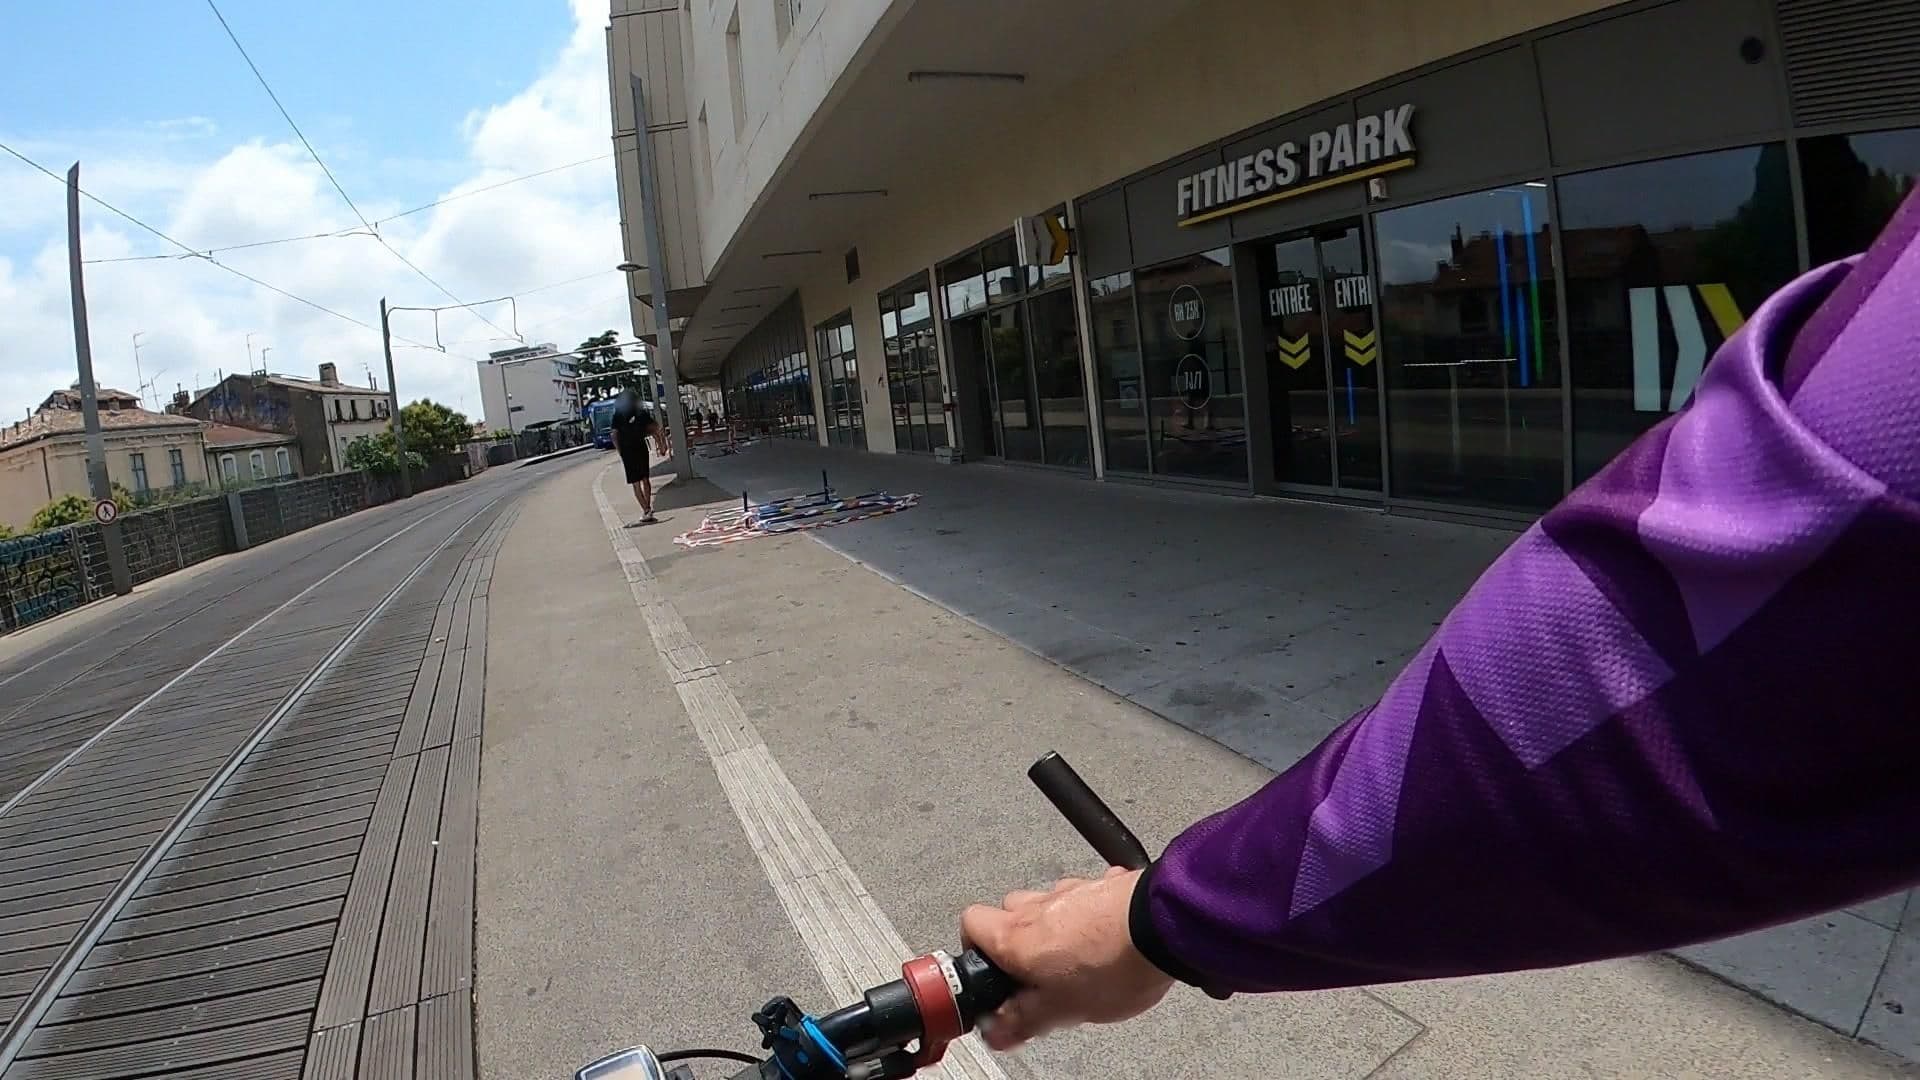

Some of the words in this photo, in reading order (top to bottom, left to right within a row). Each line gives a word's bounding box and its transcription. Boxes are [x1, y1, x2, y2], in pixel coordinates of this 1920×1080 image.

[1177, 142, 1299, 215] FITNESS
[1309, 103, 1415, 176] PARK
[1269, 278, 1313, 316] ENTRÉE
